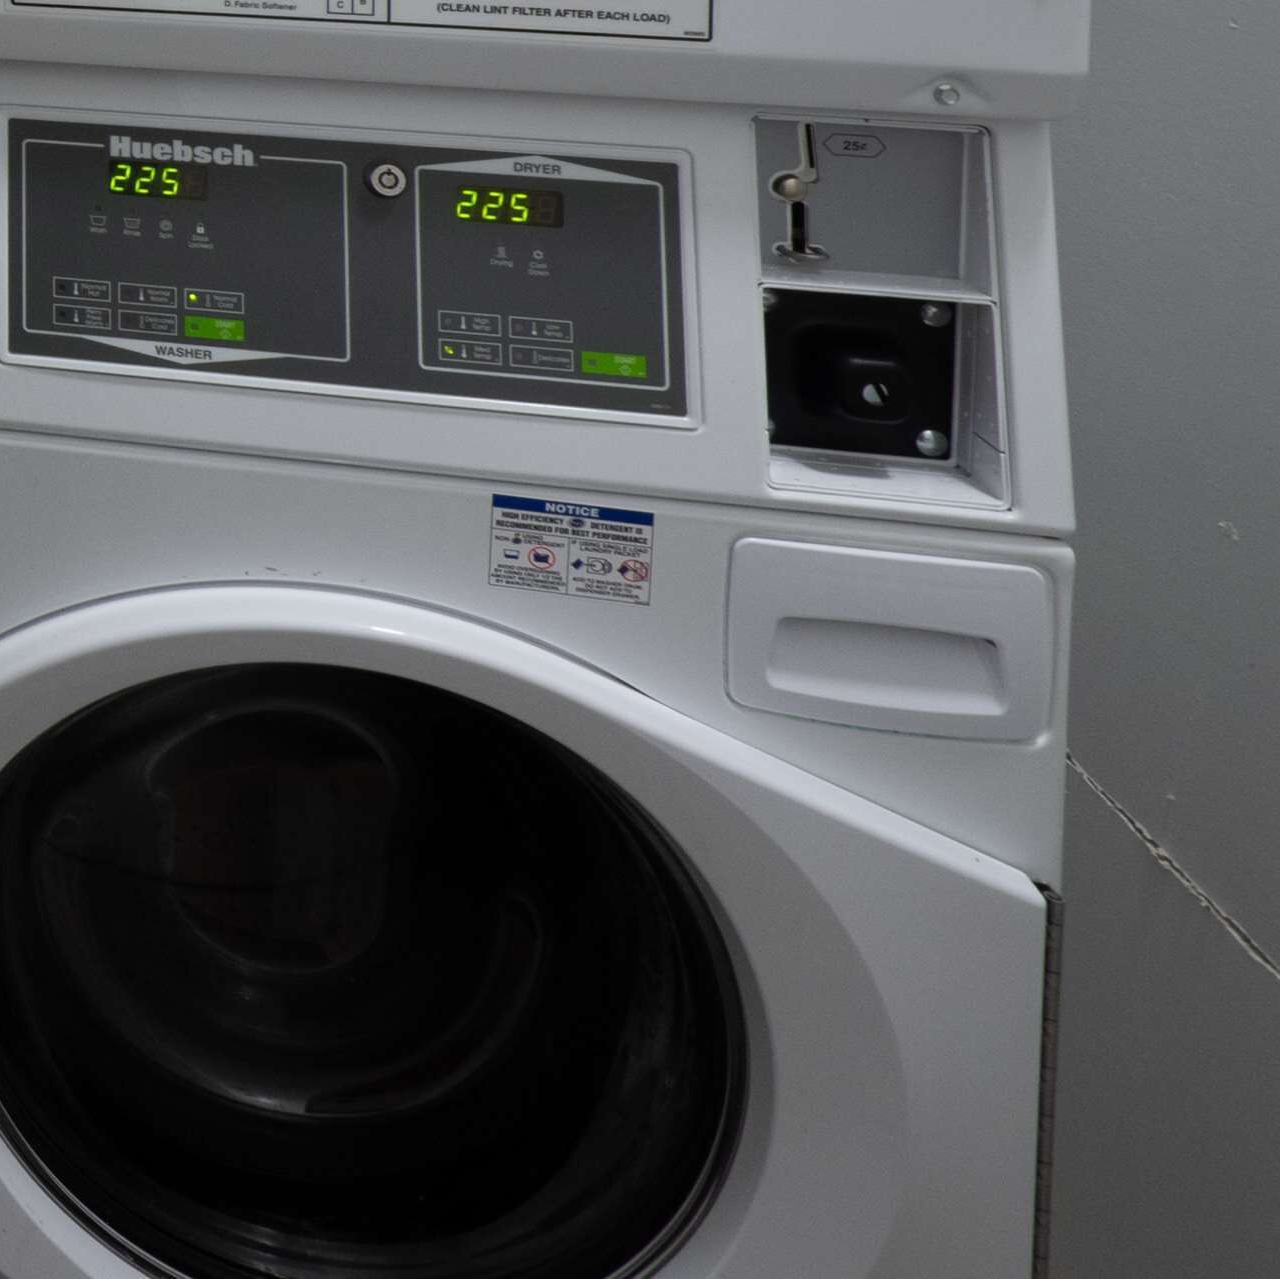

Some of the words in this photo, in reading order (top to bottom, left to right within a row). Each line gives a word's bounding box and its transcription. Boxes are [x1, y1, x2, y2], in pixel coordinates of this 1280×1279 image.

[437, 3, 480, 13] (CLEAN
[484, 5, 509, 14] LINT
[513, 7, 551, 16] FILTER
[555, 9, 593, 19] AFTER
[597, 12, 629, 21] EACH
[633, 13, 670, 24] LOAD)
[109, 135, 255, 167] Huebsch
[110, 164, 179, 196] 225
[513, 162, 562, 175] DRYER
[457, 191, 529, 222] 225
[155, 345, 212, 361] WASHER
[545, 503, 600, 517] NOTICE
[496, 520, 552, 533] RECOMMENDED
[555, 527, 569, 535] FOR
[571, 529, 590, 537] BEST
[592, 531, 648, 545] PERFORMANCE
